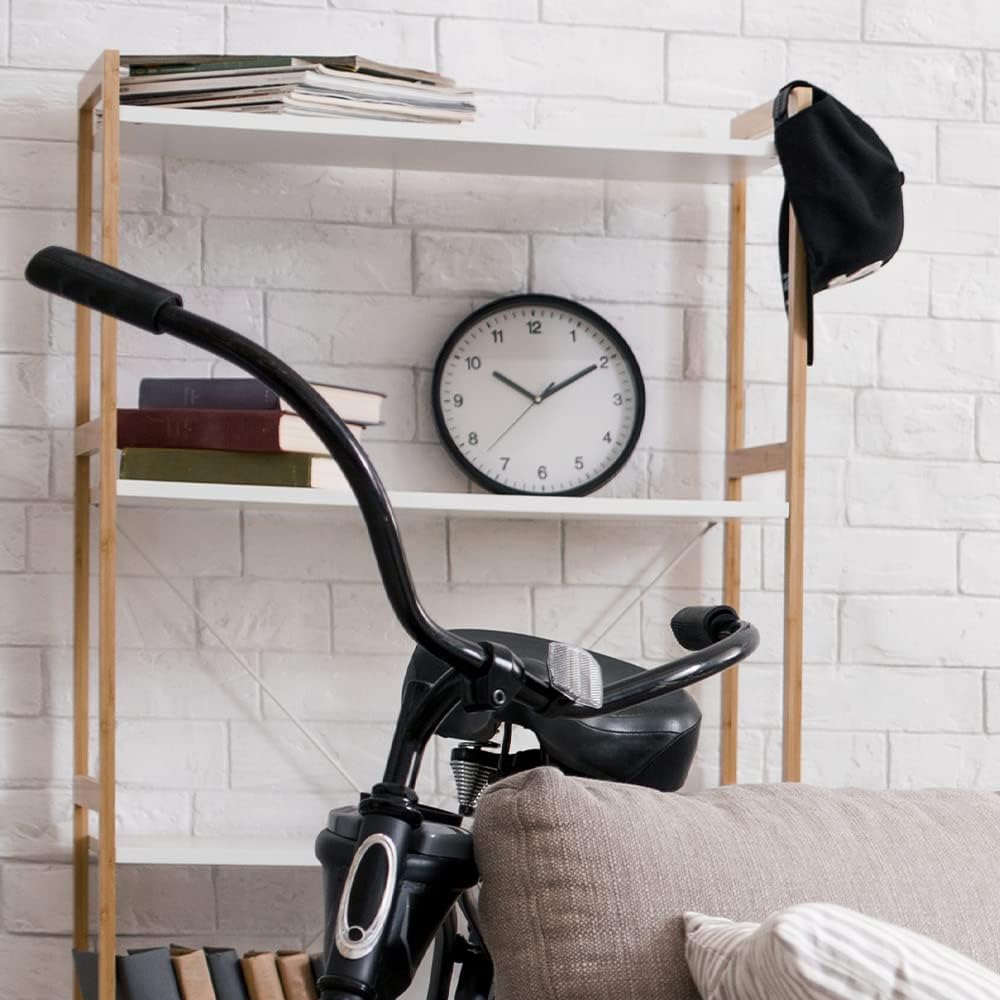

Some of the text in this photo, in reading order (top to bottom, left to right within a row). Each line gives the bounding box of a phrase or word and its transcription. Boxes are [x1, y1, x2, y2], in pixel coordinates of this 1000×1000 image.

[527, 320, 542, 335] 12
[491, 329, 504, 344] 11
[569, 329, 577, 343] 1
[465, 355, 482, 370] 10
[599, 356, 610, 370] 2
[453, 393, 464, 408] 9
[612, 393, 624, 407] 3
[468, 431, 479, 446] 8
[602, 430, 613, 444] 4
[500, 456, 511, 471] 7
[574, 455, 585, 470] 5
[537, 465, 548, 480] 6
